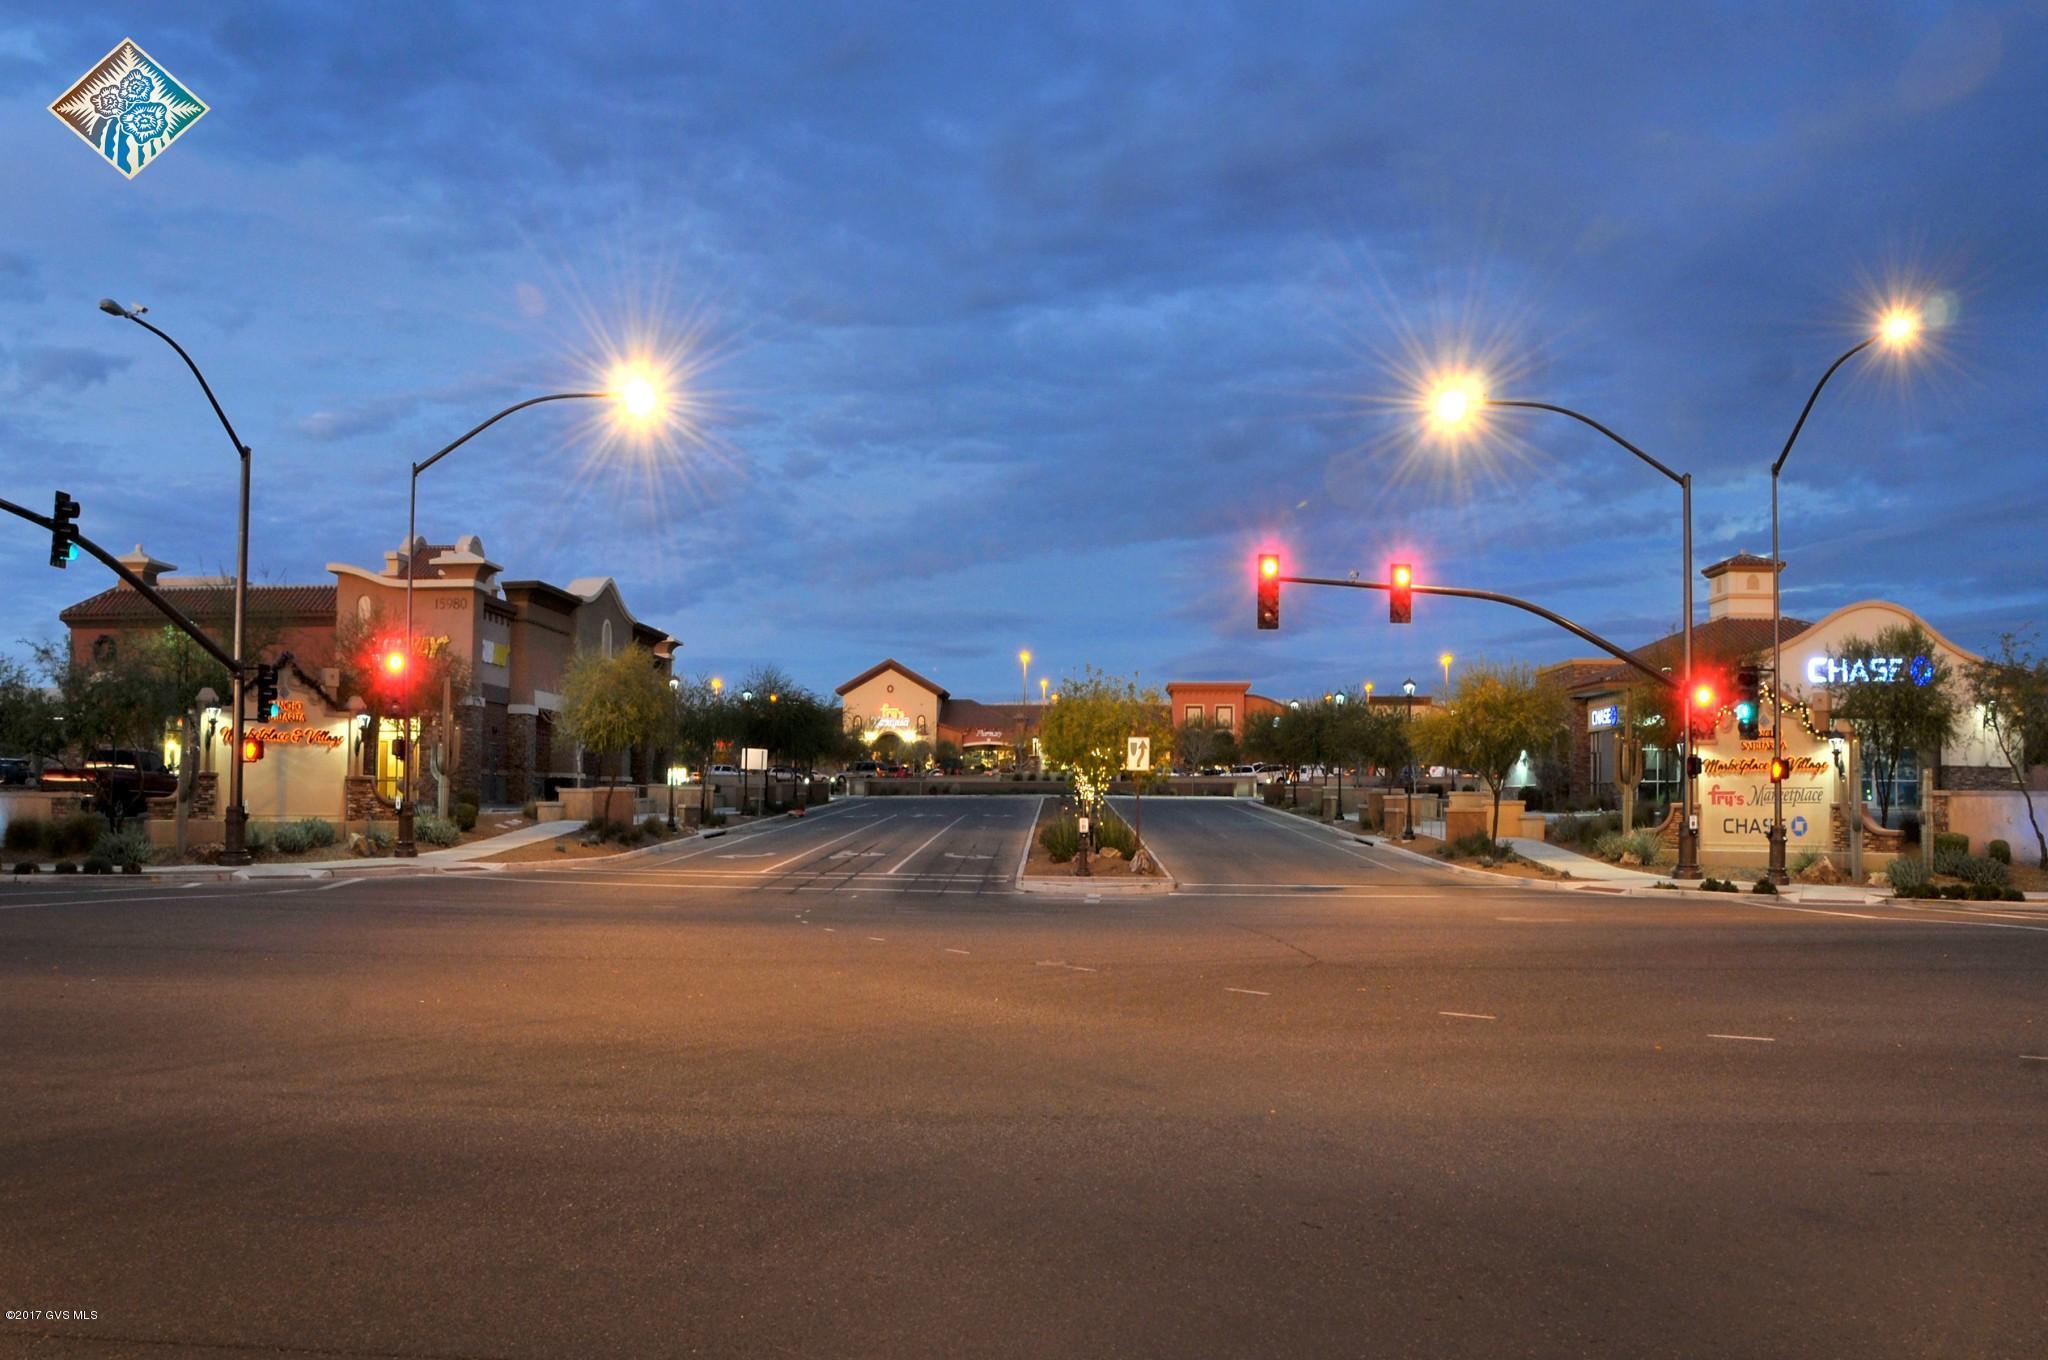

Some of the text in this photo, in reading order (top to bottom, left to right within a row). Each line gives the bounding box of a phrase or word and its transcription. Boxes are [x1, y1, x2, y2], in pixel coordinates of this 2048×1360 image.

[434, 598, 468, 611] 15980
[1807, 656, 1904, 683] CHASE
[290, 727, 303, 743] &
[1708, 784, 1745, 807] fry's
